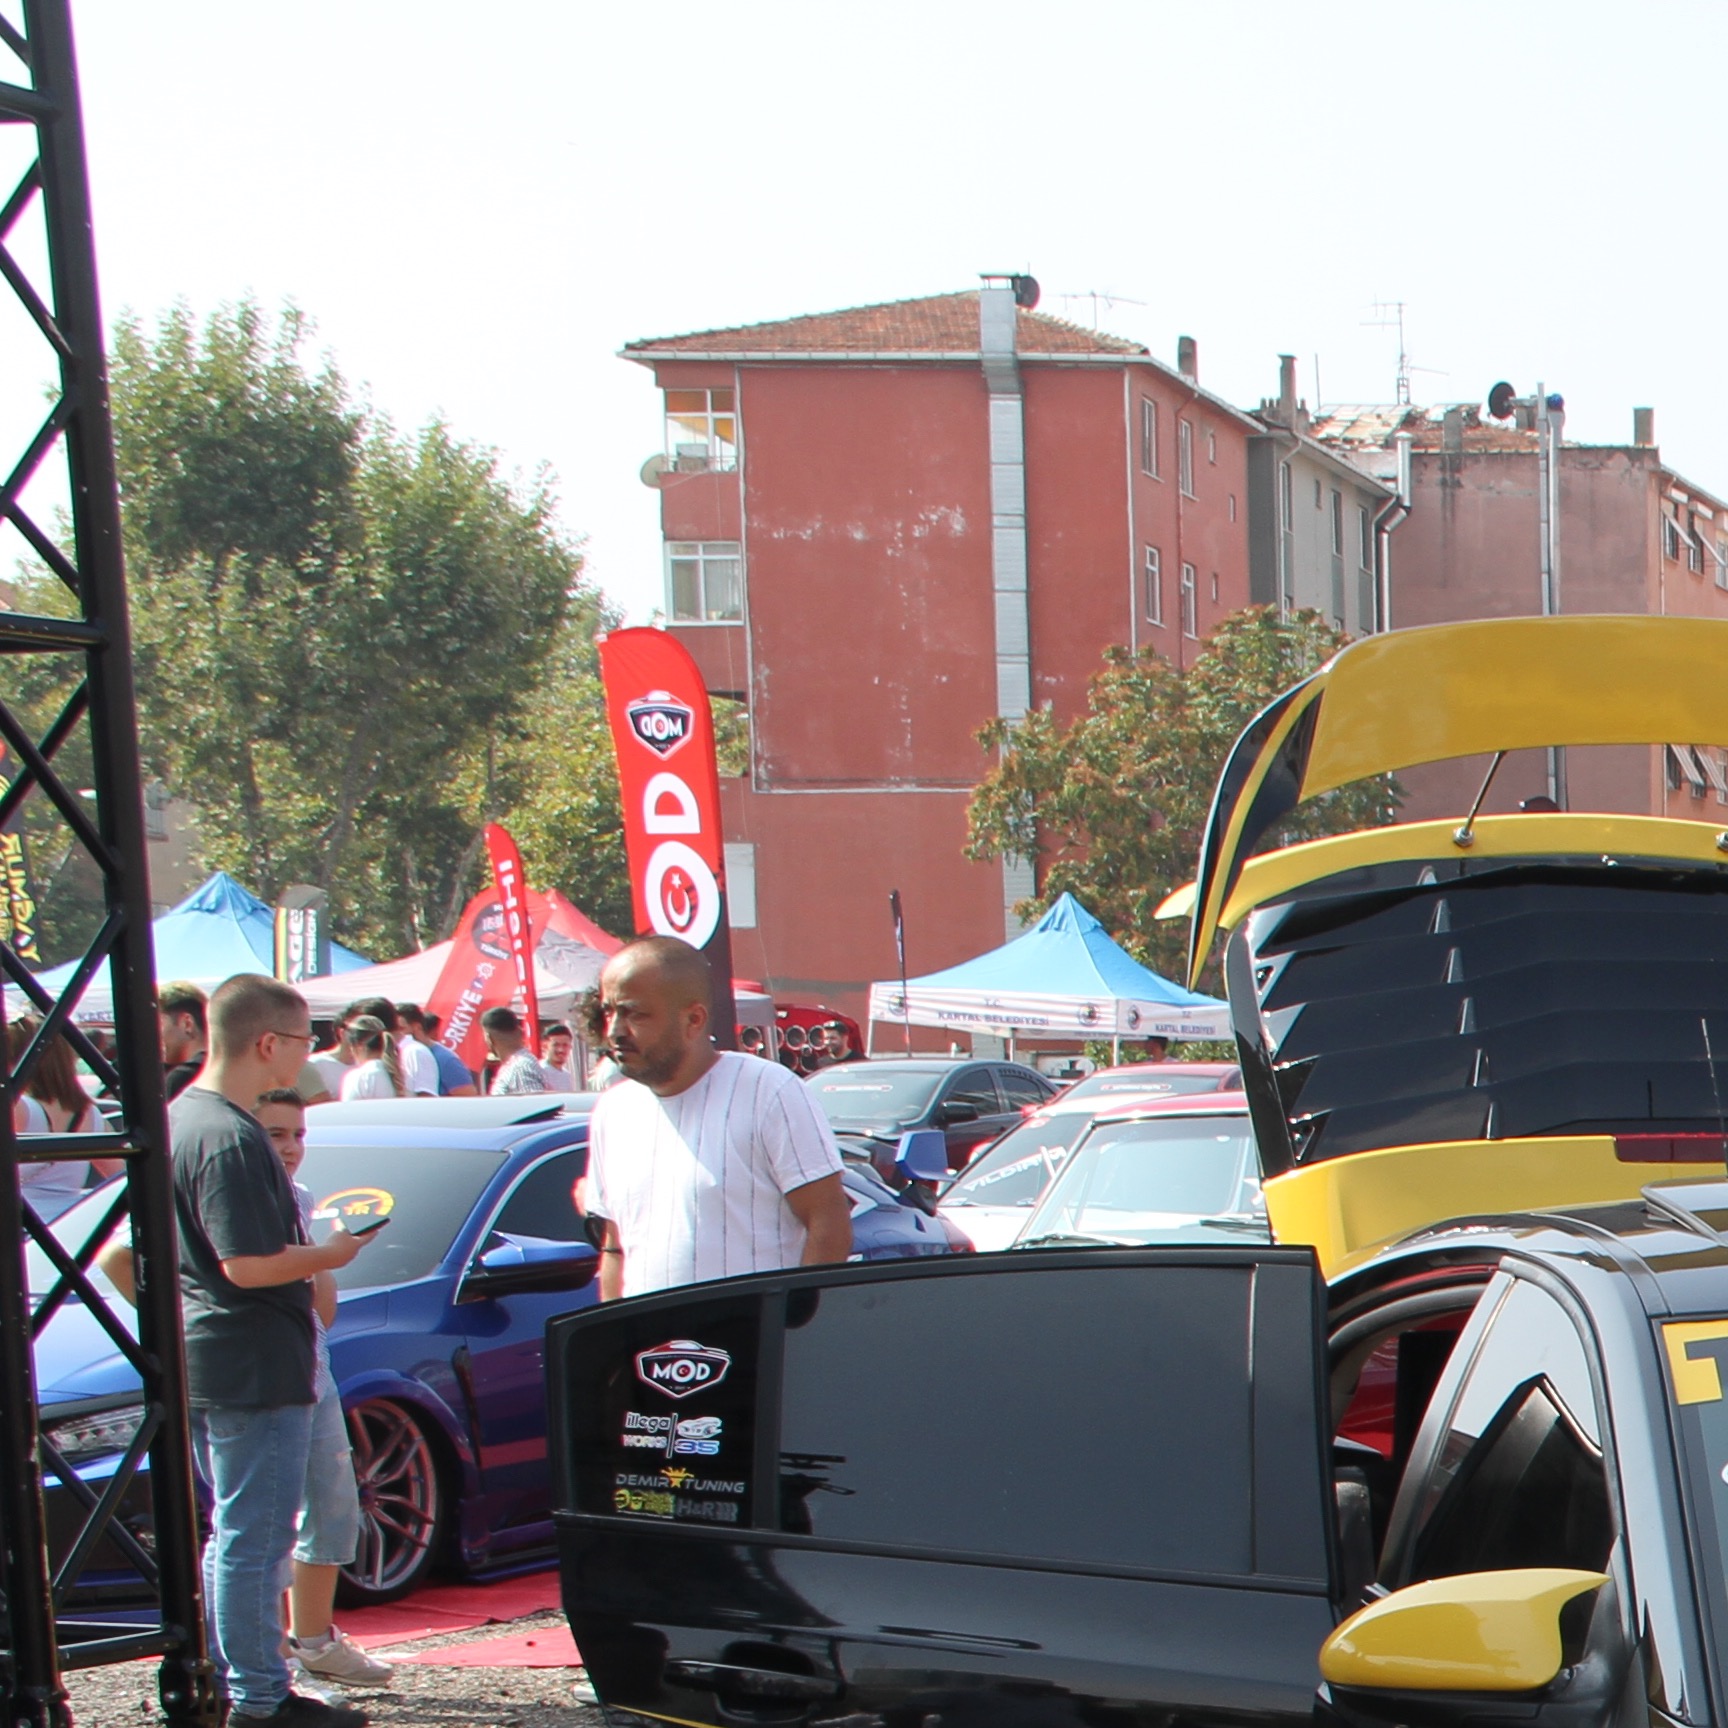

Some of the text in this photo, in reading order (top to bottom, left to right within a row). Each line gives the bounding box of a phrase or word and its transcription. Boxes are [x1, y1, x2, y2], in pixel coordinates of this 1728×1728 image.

[938, 1012, 982, 1023] KARTAL
[652, 1359, 711, 1383] MOD
[674, 1438, 720, 1456] 35
[684, 1477, 746, 1494] TUNING
